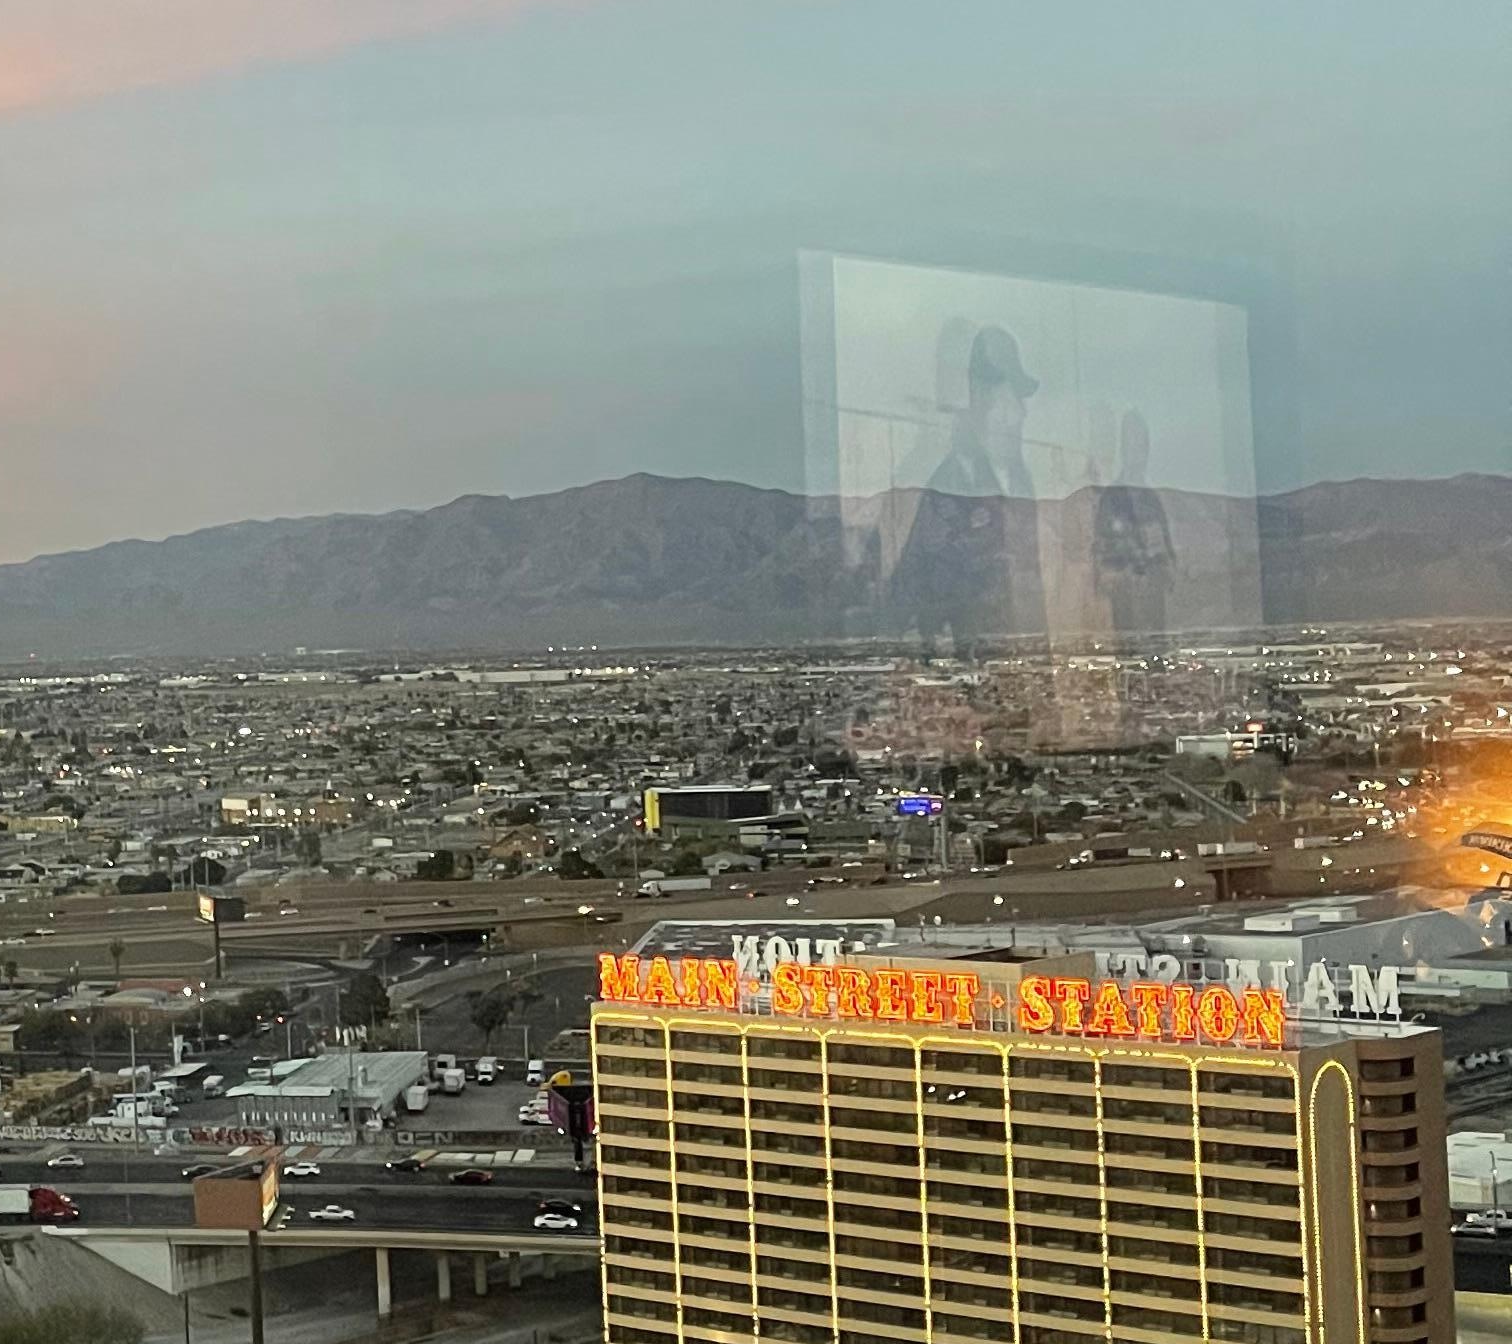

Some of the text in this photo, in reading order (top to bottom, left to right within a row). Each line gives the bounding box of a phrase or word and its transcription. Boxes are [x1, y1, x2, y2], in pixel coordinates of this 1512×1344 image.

[599, 953, 1286, 1046] MAIN STREET STATION
